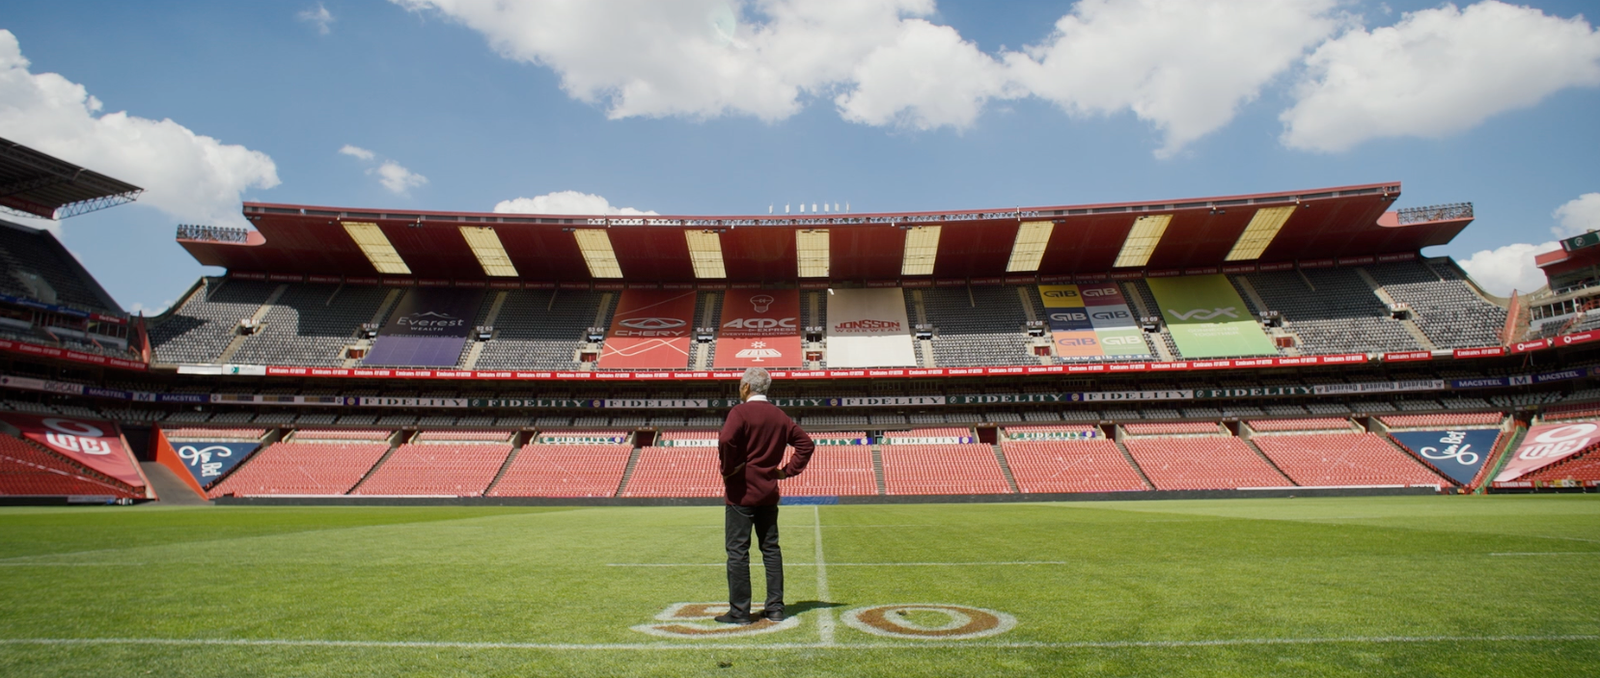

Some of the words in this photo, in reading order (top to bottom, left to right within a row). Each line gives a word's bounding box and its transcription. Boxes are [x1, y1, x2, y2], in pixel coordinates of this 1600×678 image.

[397, 316, 464, 326] Everest
[834, 319, 900, 330] JONSSON
[1538, 371, 1578, 382] MACSTEEL
[89, 388, 126, 398] MACSTEEL
[1088, 391, 1190, 400] FIDELITY
[1211, 386, 1314, 398] FIDELITY
[364, 398, 464, 406] FIDELITY
[488, 399, 585, 407] FIDELITY
[965, 394, 1062, 404] FIDELITY
